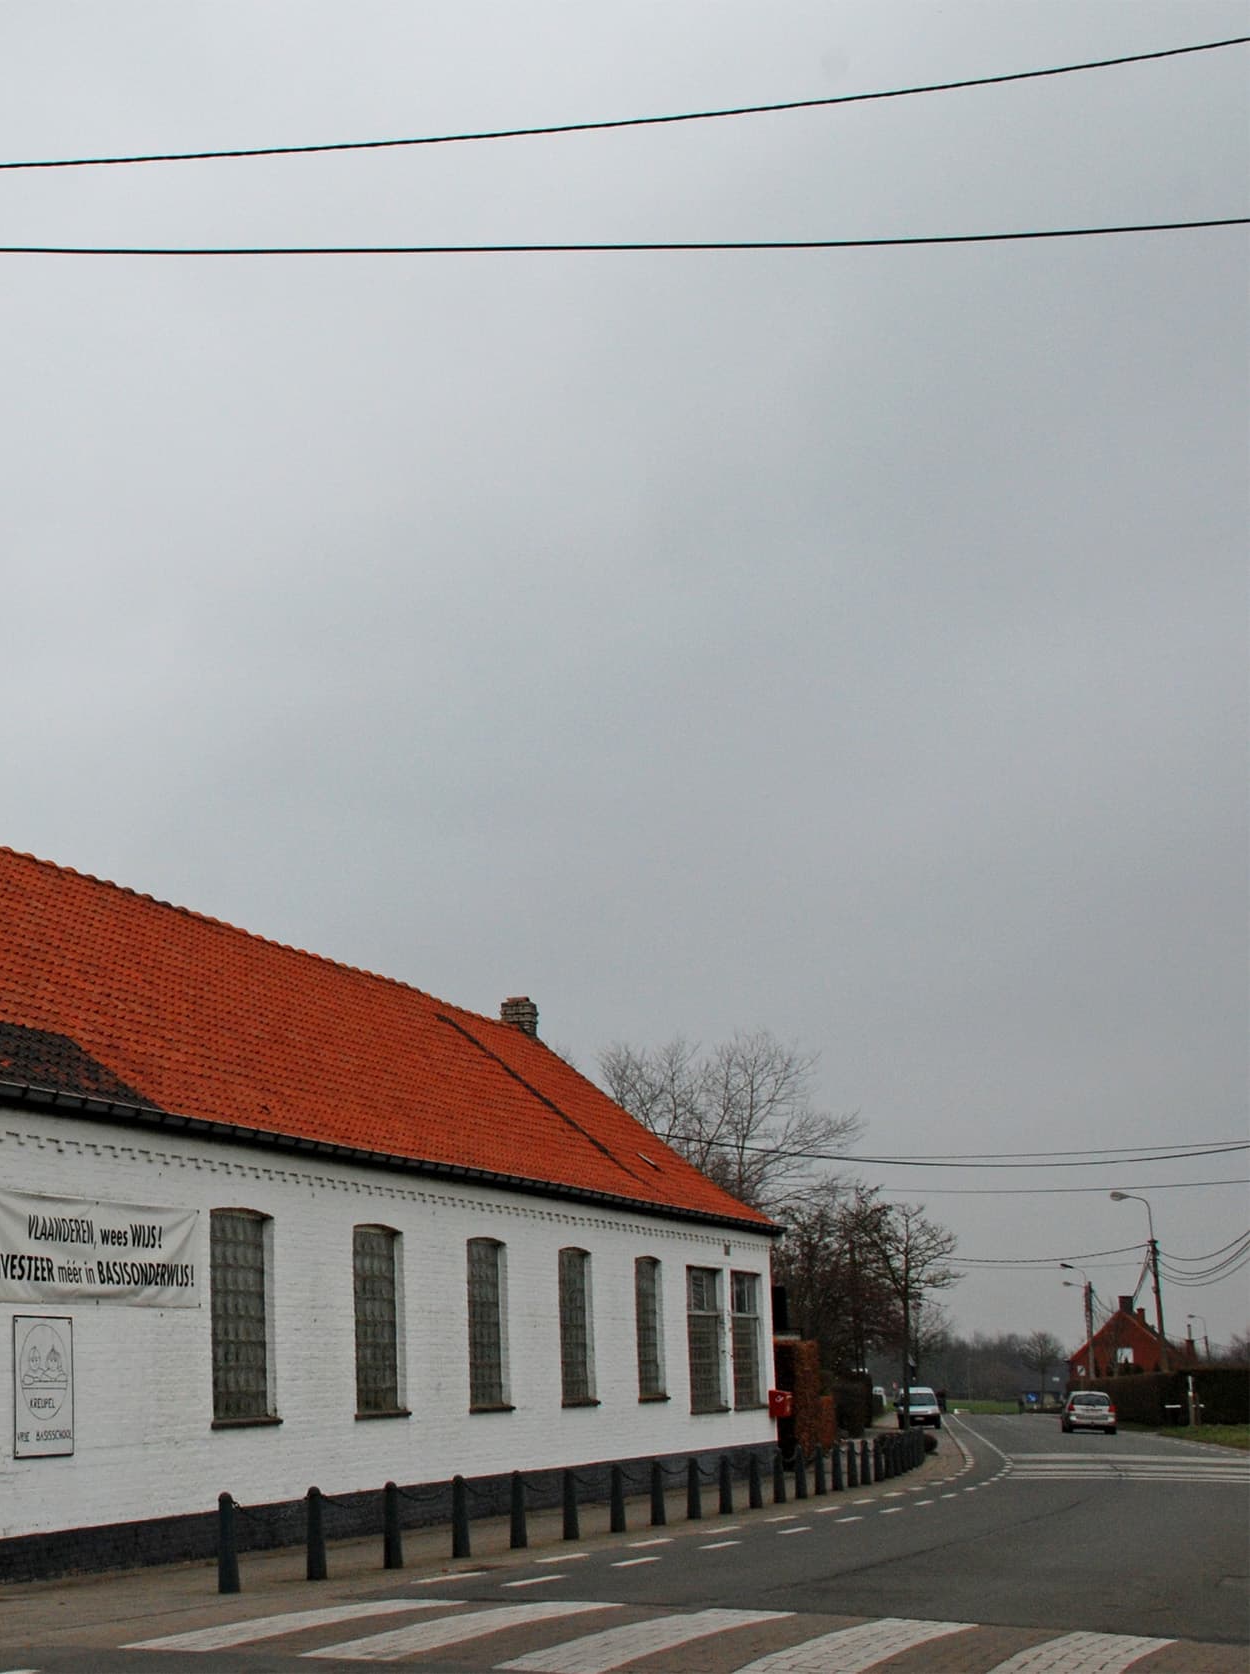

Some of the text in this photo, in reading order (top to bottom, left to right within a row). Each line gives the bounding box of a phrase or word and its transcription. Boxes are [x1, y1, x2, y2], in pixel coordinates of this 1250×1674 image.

[27, 1214, 163, 1250] VLAANDEREN, wees WIJS!
[58, 1258, 83, 1284] méér
[84, 1261, 96, 1285] in
[97, 1260, 195, 1288] BASISONDERWIJS!
